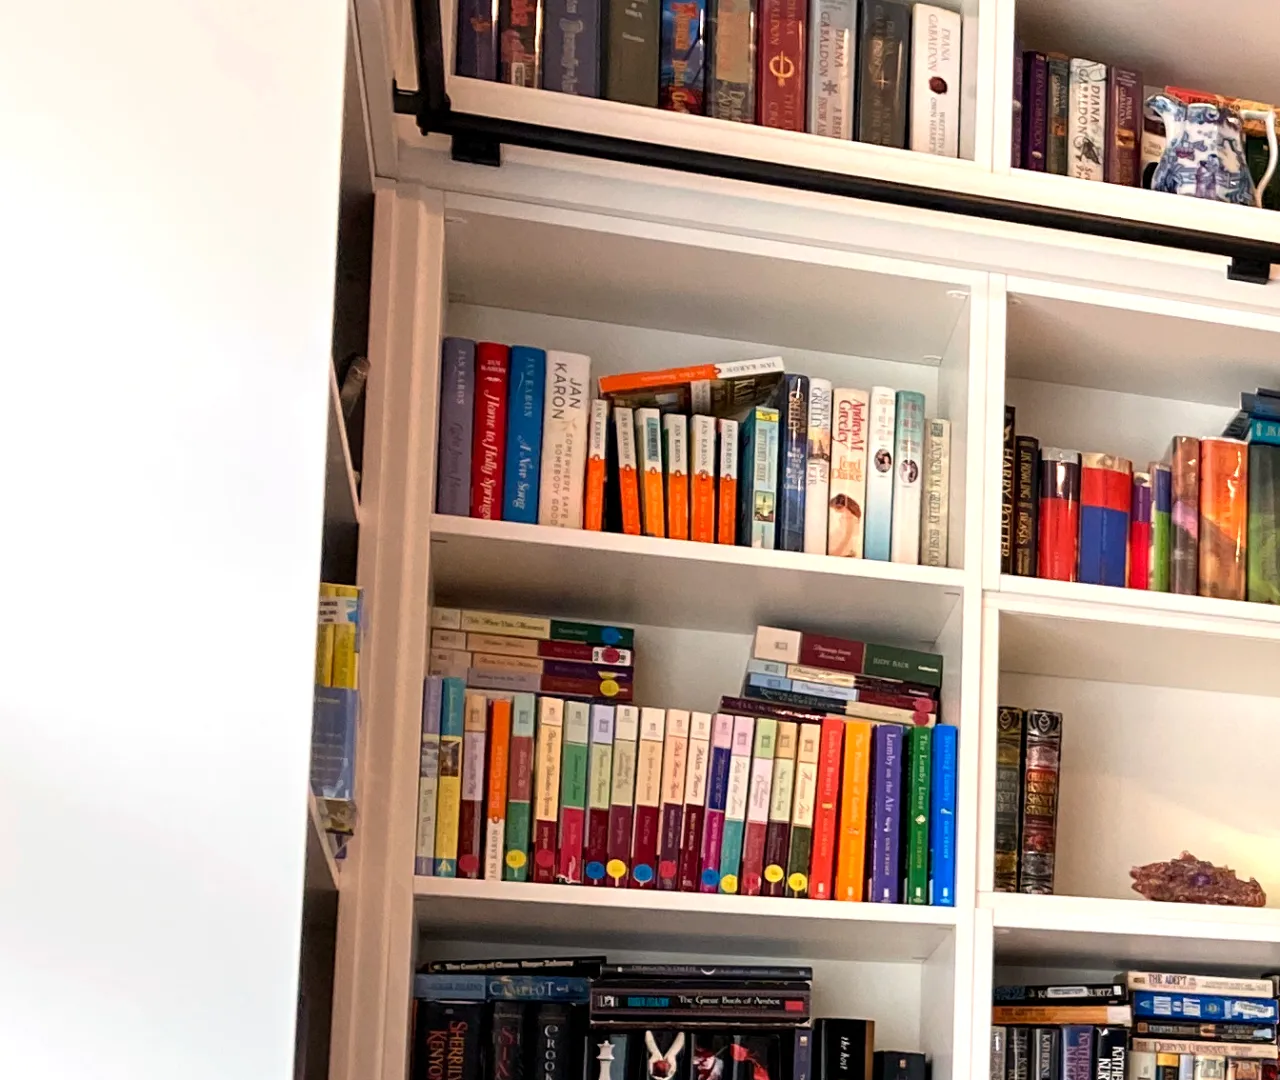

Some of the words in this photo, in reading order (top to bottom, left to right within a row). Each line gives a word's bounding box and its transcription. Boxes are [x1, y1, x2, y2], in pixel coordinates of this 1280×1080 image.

[819, 11, 830, 77] GABALDON
[835, 29, 844, 68] DIANA
[1090, 83, 1100, 123] DIANA
[552, 362, 568, 420] KARON
[569, 378, 582, 409] JAN
